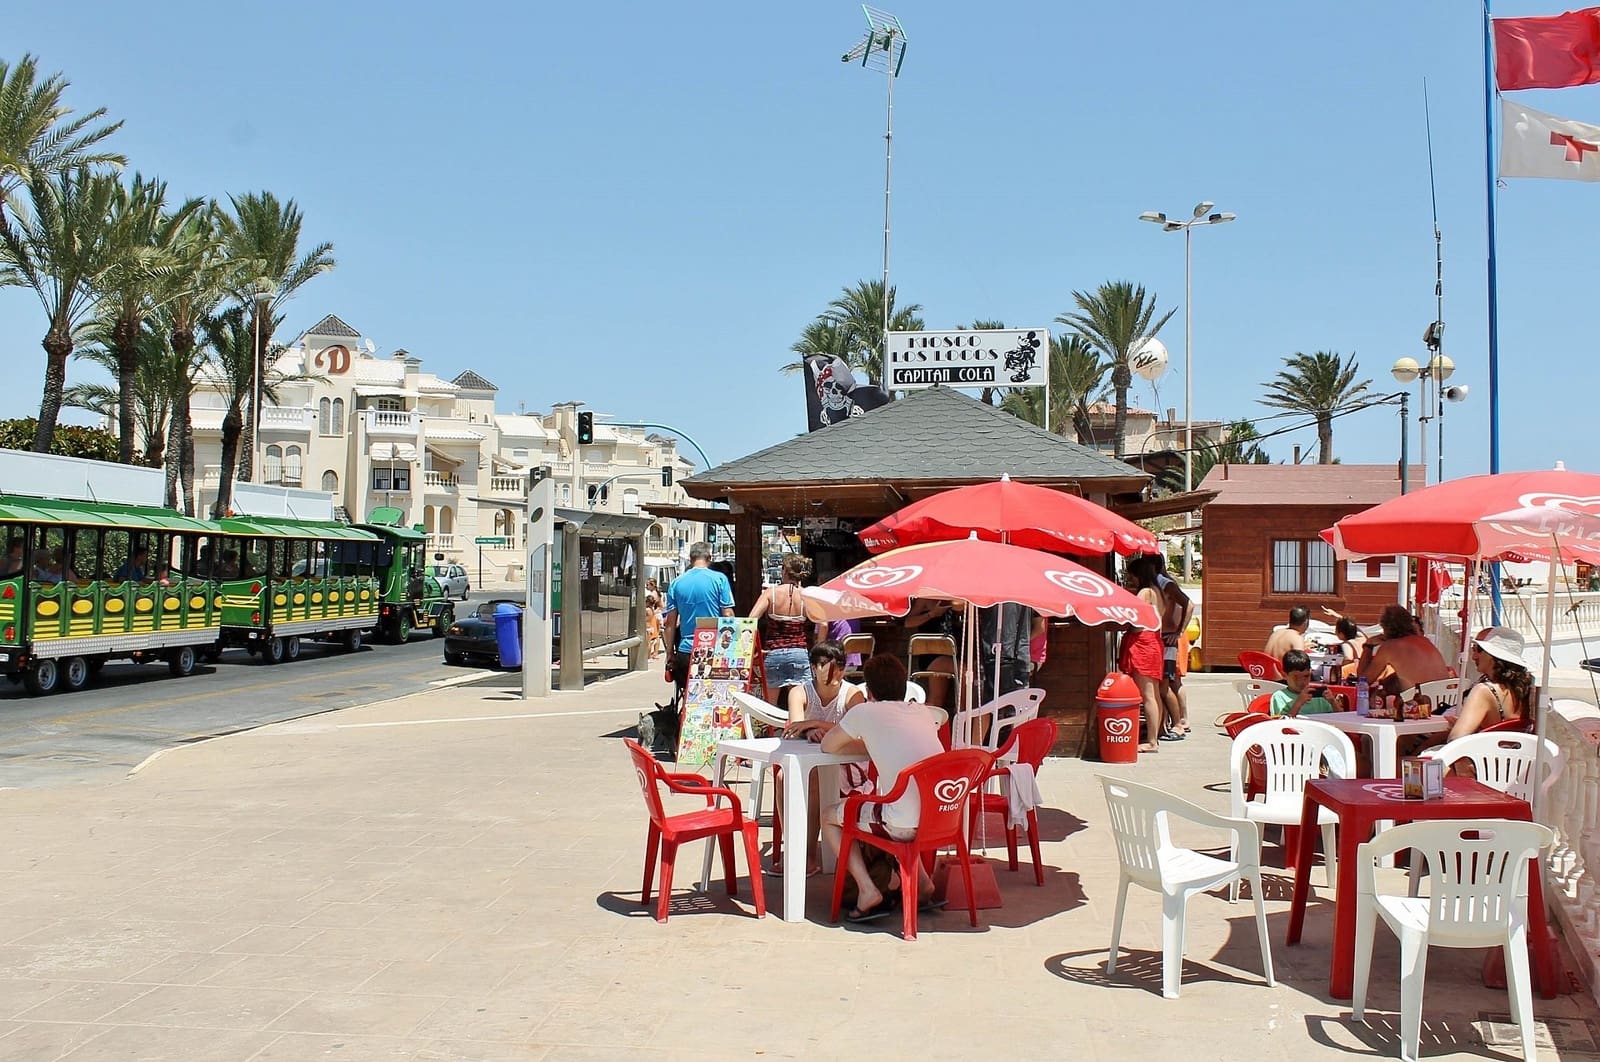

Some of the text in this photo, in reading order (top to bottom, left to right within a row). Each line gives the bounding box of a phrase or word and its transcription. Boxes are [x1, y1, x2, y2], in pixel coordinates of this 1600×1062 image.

[908, 335, 982, 348] KIOSCO
[892, 349, 999, 363] LOS LOCOS
[896, 367, 993, 383] CAPITAN COLA
[1107, 735, 1131, 743] FRIGO
[938, 803, 959, 812] FRIGO
